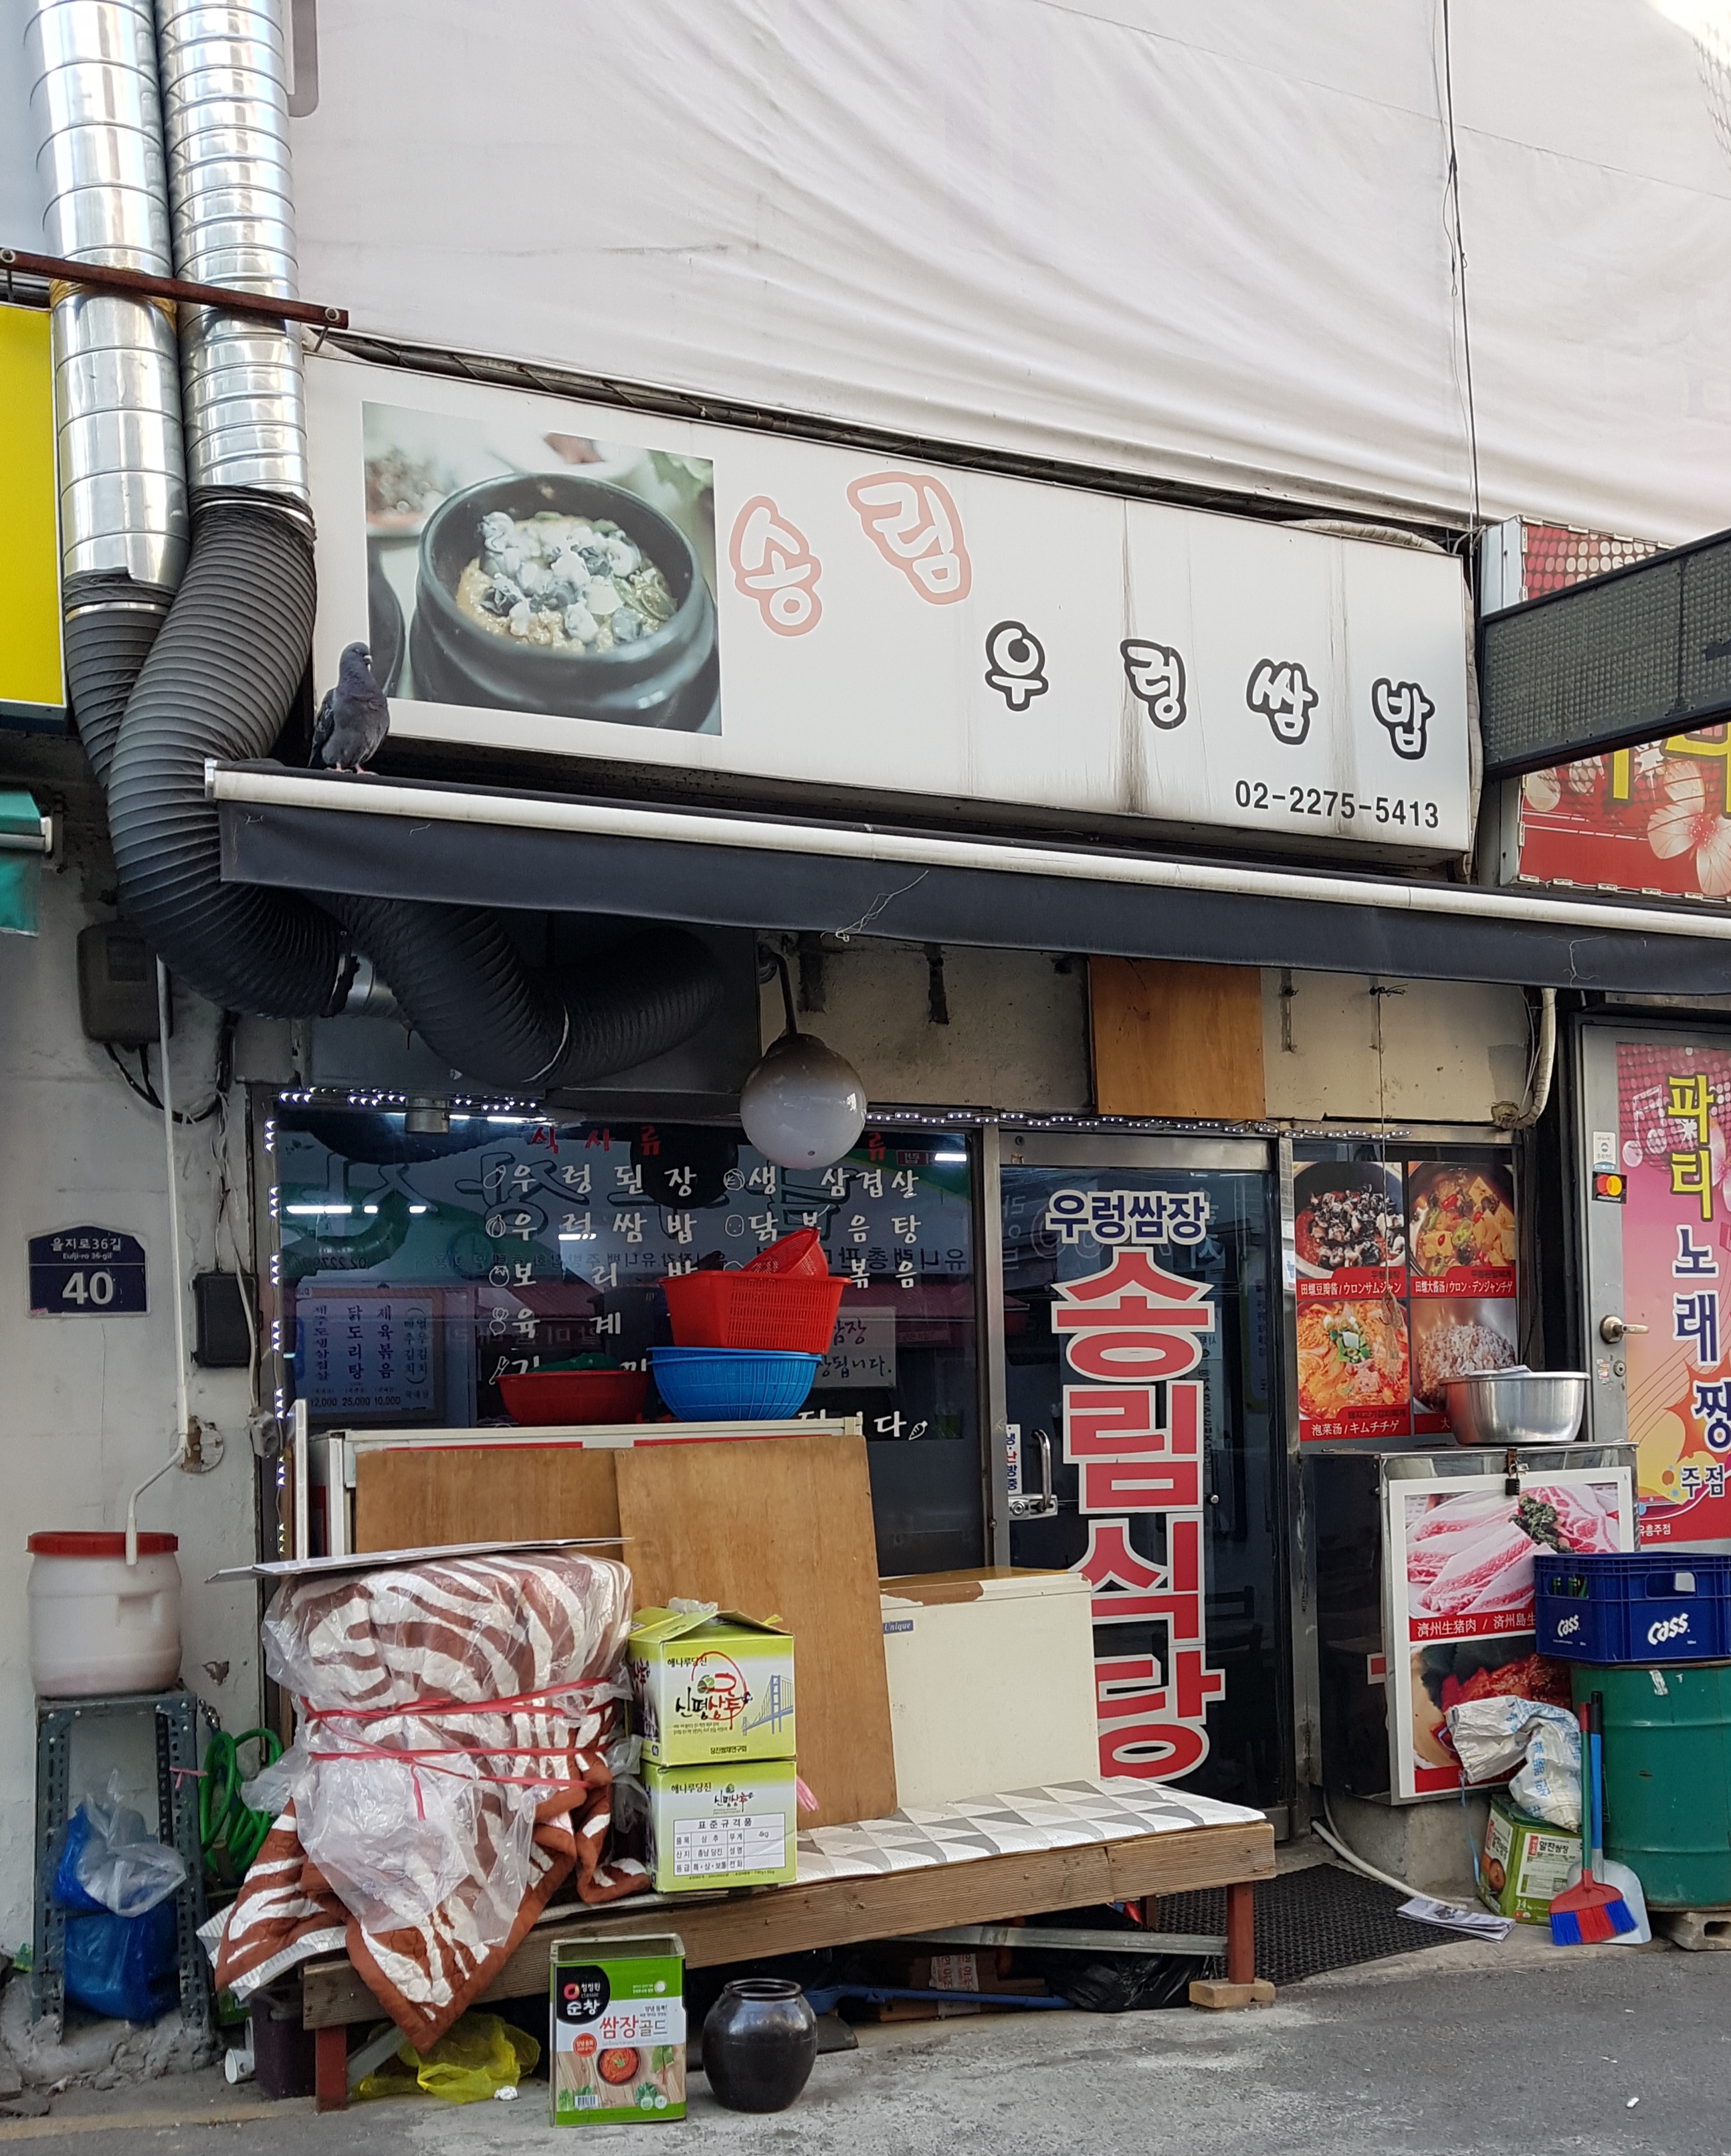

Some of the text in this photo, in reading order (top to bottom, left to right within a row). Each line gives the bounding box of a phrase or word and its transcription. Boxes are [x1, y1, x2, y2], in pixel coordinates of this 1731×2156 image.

[728, 471, 972, 637] 송림
[985, 620, 1435, 760] 우렁쌈밥
[1235, 779, 1439, 829] 02-2275-5413
[1667, 1074, 1714, 1222] 파티
[510, 1163, 697, 1197] 우렁된장
[512, 1211, 697, 1244] 우렁쌈밥
[1046, 1189, 1209, 1244] 우렁쌈장
[50, 1237, 122, 1252] 을지로36길
[62, 1271, 114, 1305] 40
[347, 1304, 364, 1380] 닭도리탕
[377, 1304, 395, 1379] 제육볶음
[1681, 1464, 1726, 1499] 주점
[1051, 1247, 1225, 1782] 송림식당
[884, 1621, 912, 1632] Unique
[698, 1818, 752, 1830] 표준규격품
[566, 1999, 601, 2016] 순창
